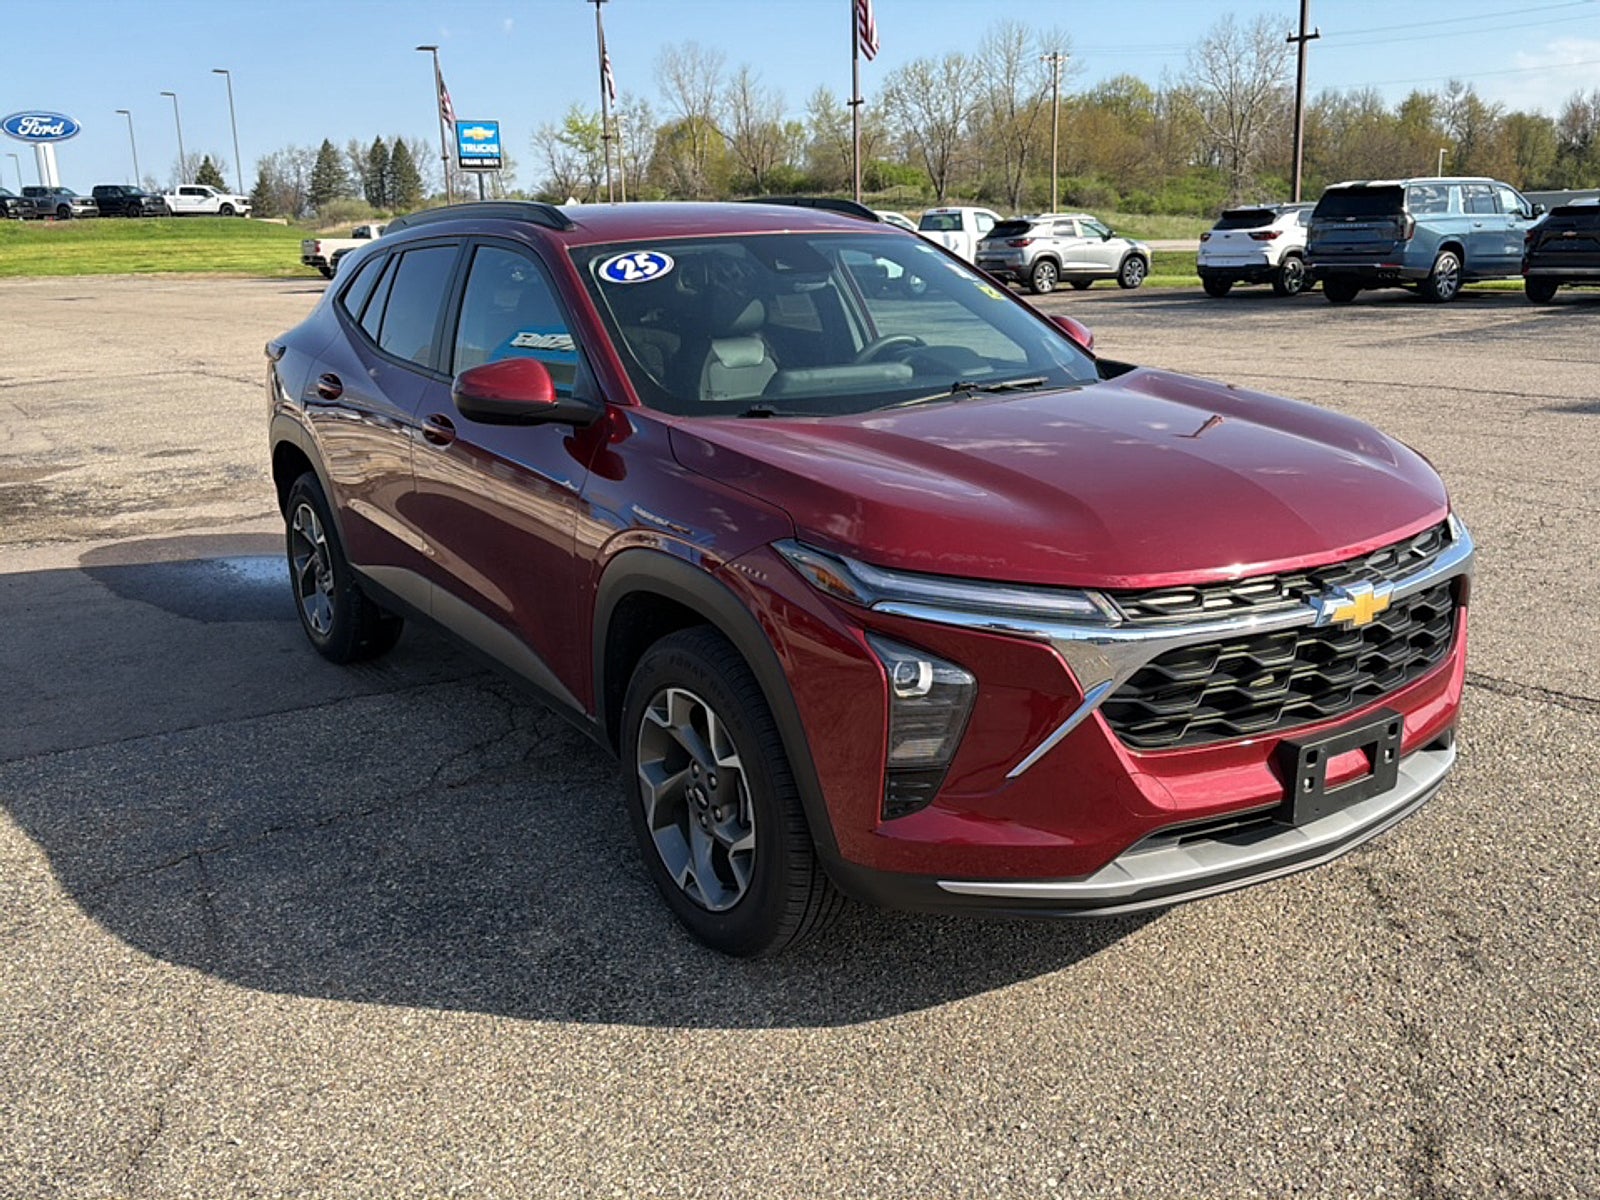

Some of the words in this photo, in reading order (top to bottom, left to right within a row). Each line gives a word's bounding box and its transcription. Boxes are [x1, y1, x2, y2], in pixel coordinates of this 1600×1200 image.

[18, 117, 64, 135] Ford
[461, 144, 499, 153] TRUCKS
[616, 254, 658, 280] 25
